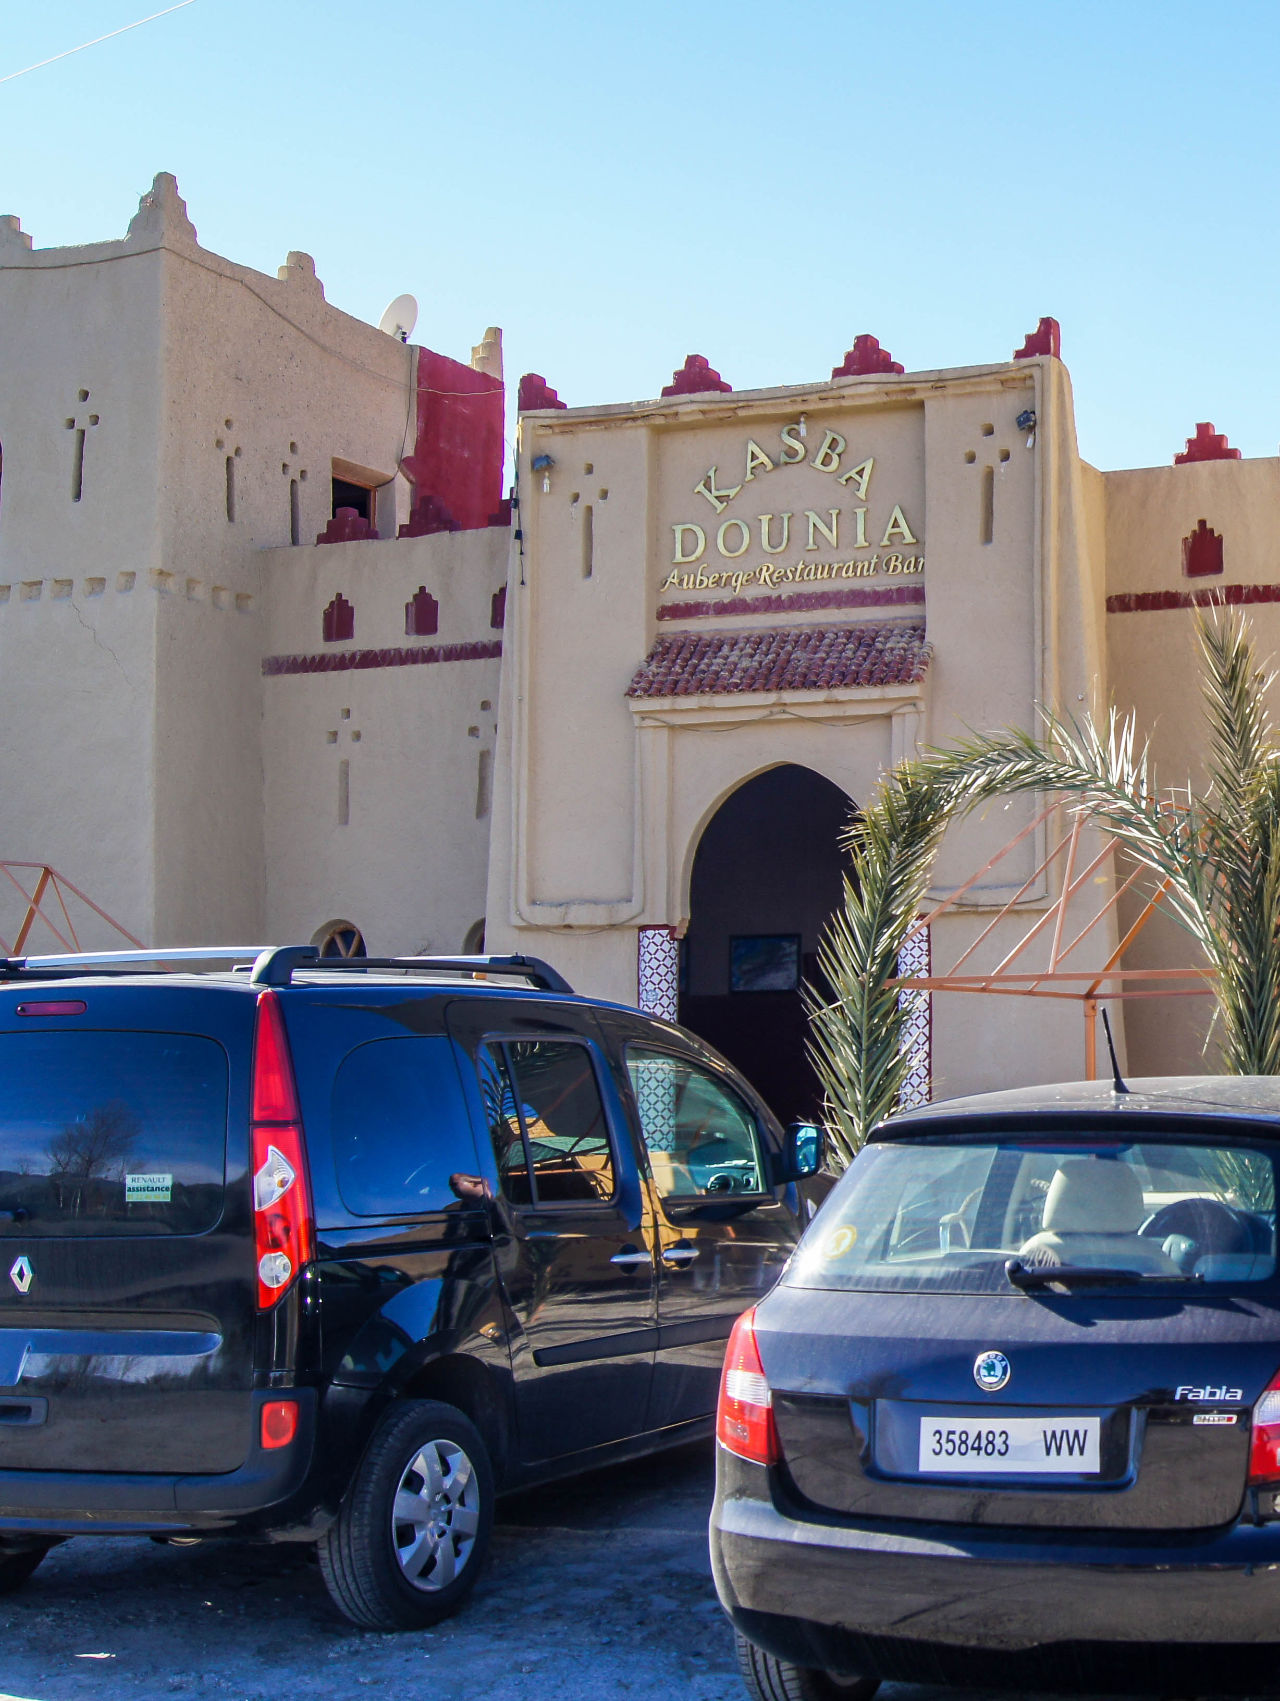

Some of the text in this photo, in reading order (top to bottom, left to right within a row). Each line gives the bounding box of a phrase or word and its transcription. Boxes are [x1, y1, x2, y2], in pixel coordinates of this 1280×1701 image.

[694, 422, 875, 514] KASBA
[671, 503, 917, 564] DOUNIA
[659, 563, 753, 594] Auberge
[755, 553, 878, 589] Restaurant
[127, 1185, 171, 1193] assistance
[131, 1176, 166, 1184] RENAULT
[1174, 1385, 1243, 1401] Fabia
[931, 1429, 1088, 1457] 358483 WW
